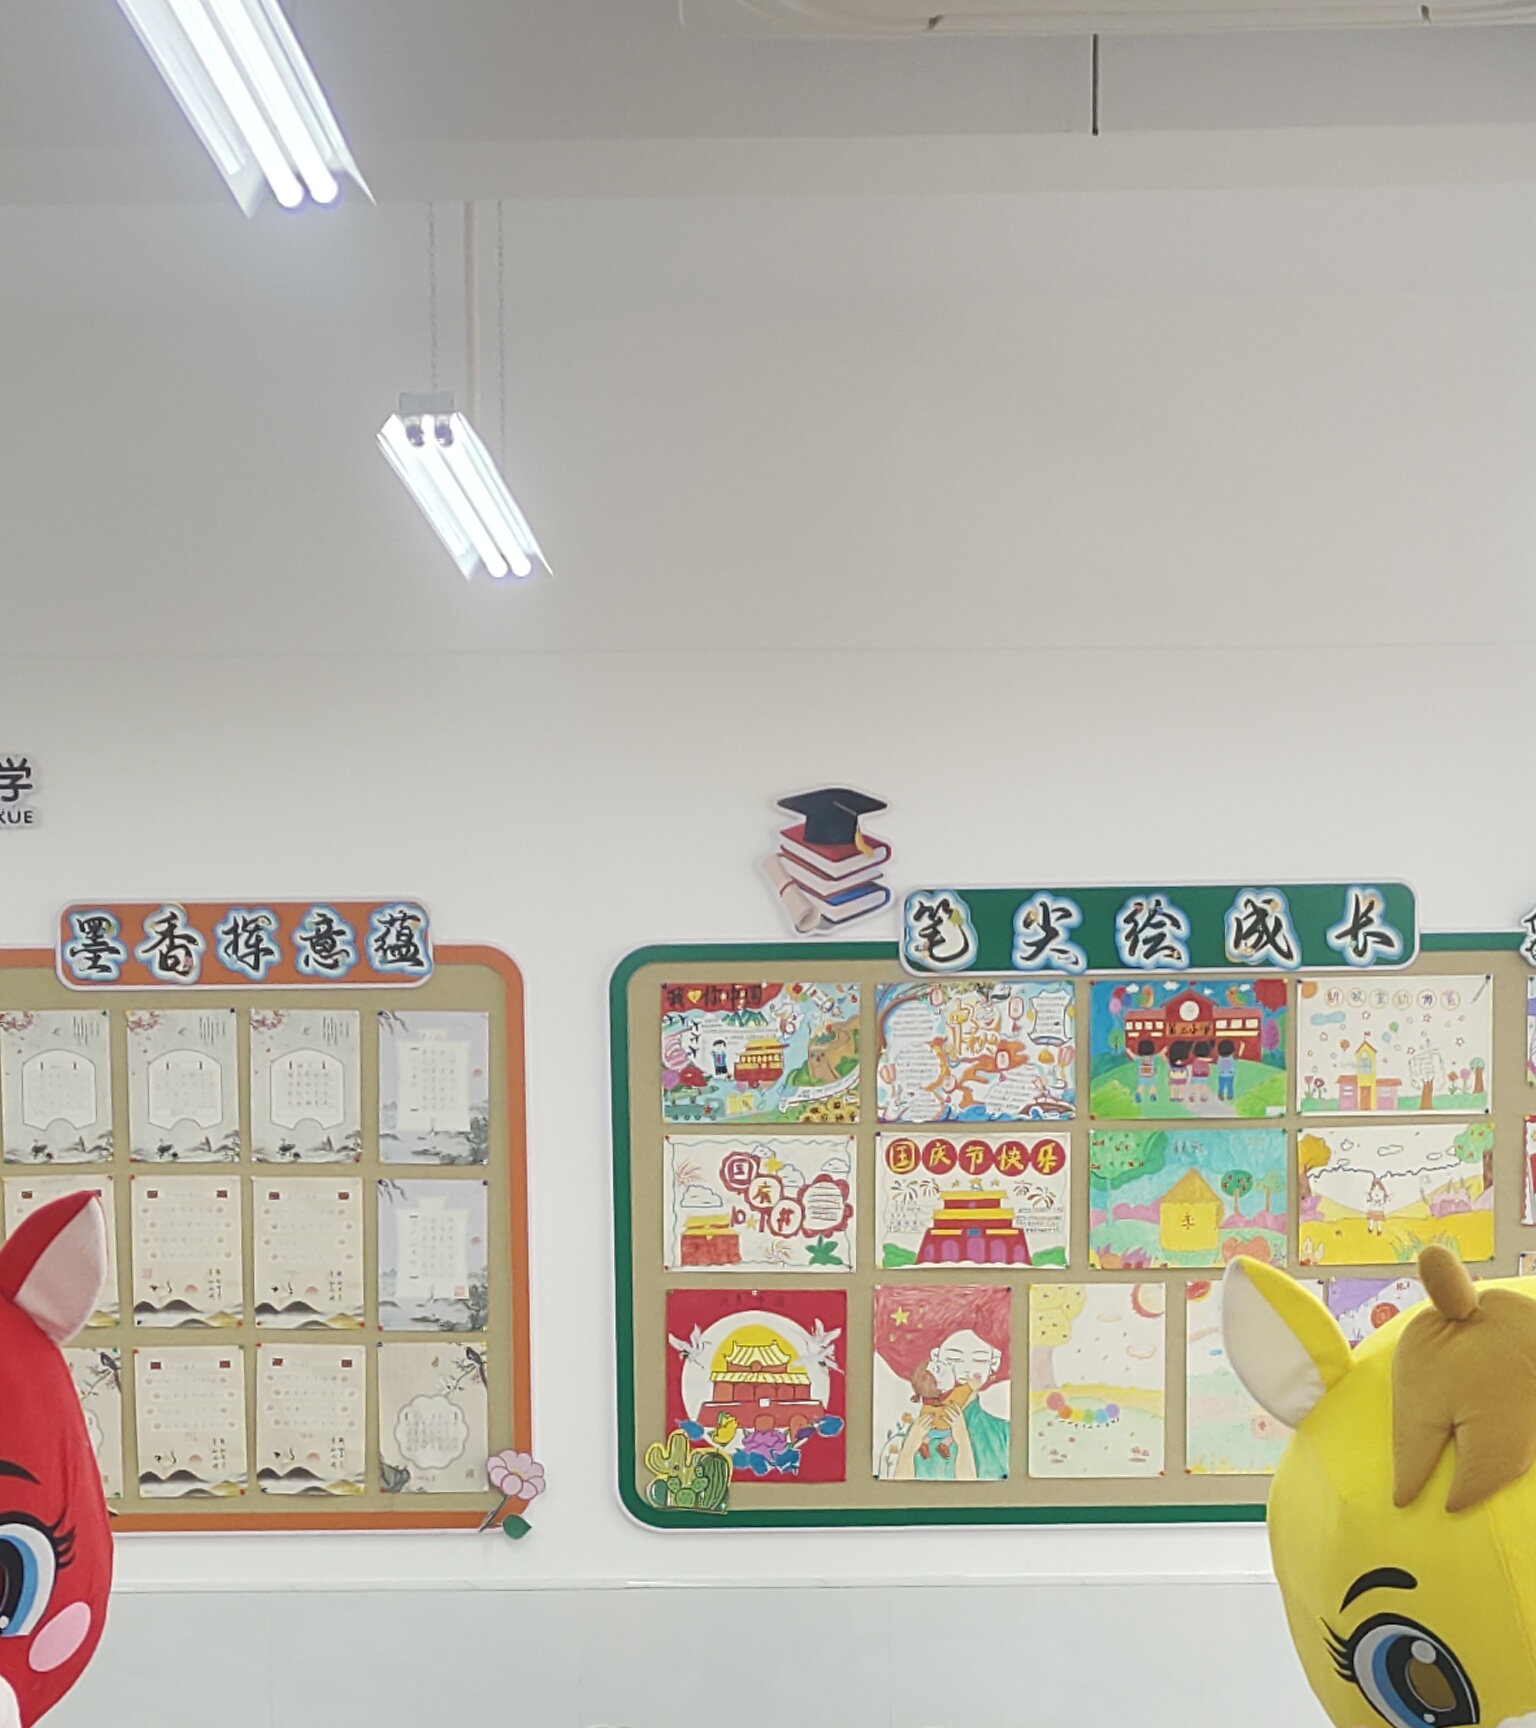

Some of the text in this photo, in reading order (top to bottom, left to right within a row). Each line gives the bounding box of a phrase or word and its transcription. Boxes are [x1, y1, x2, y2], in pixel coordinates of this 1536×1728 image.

[911, 893, 1392, 966] 笔尖绘成长
[889, 1140, 1058, 1174] 国庆节快乐
